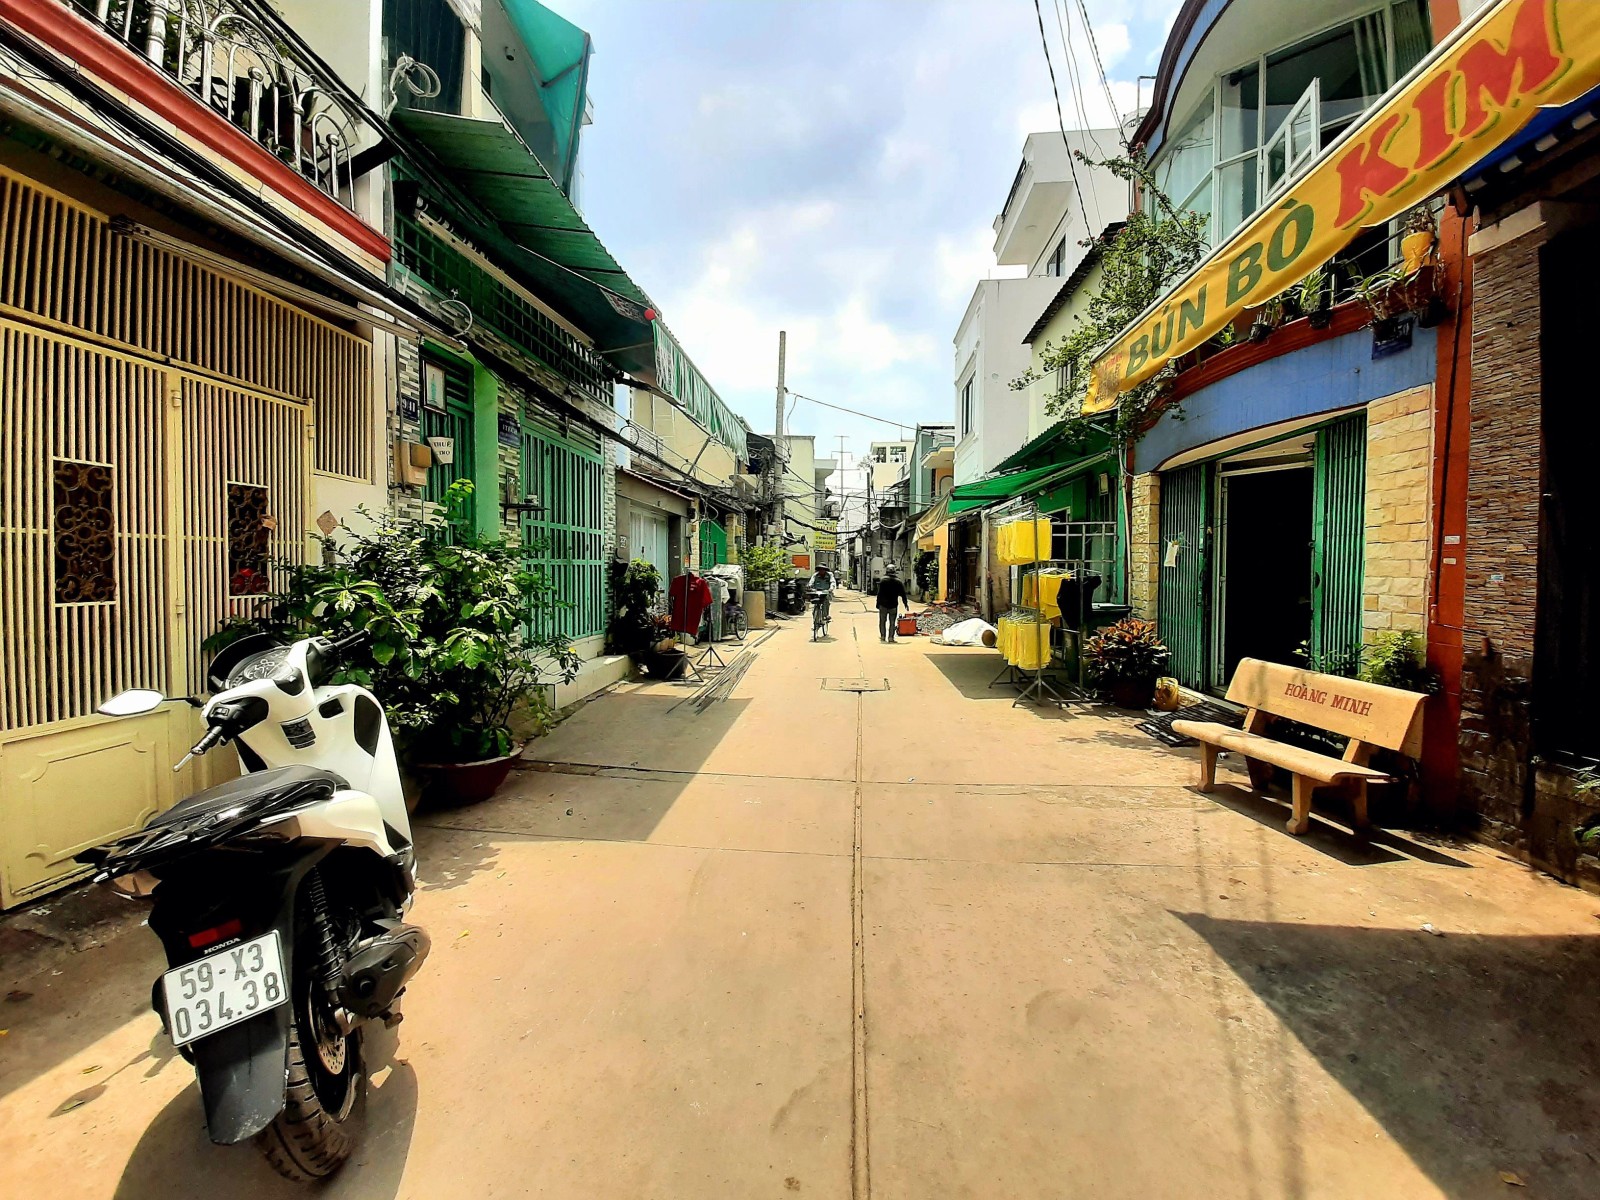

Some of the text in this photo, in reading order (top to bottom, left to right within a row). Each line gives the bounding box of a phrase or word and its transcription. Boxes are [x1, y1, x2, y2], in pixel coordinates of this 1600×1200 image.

[1126, 281, 1207, 378] BÚN
[1226, 198, 1315, 308] BÒ
[1334, 0, 1560, 228] KIM
[1284, 683, 1373, 716] HOÀNG MINH
[180, 943, 264, 1000] 59-X3
[204, 937, 241, 955] HONDA
[175, 972, 280, 1038] 034.38
